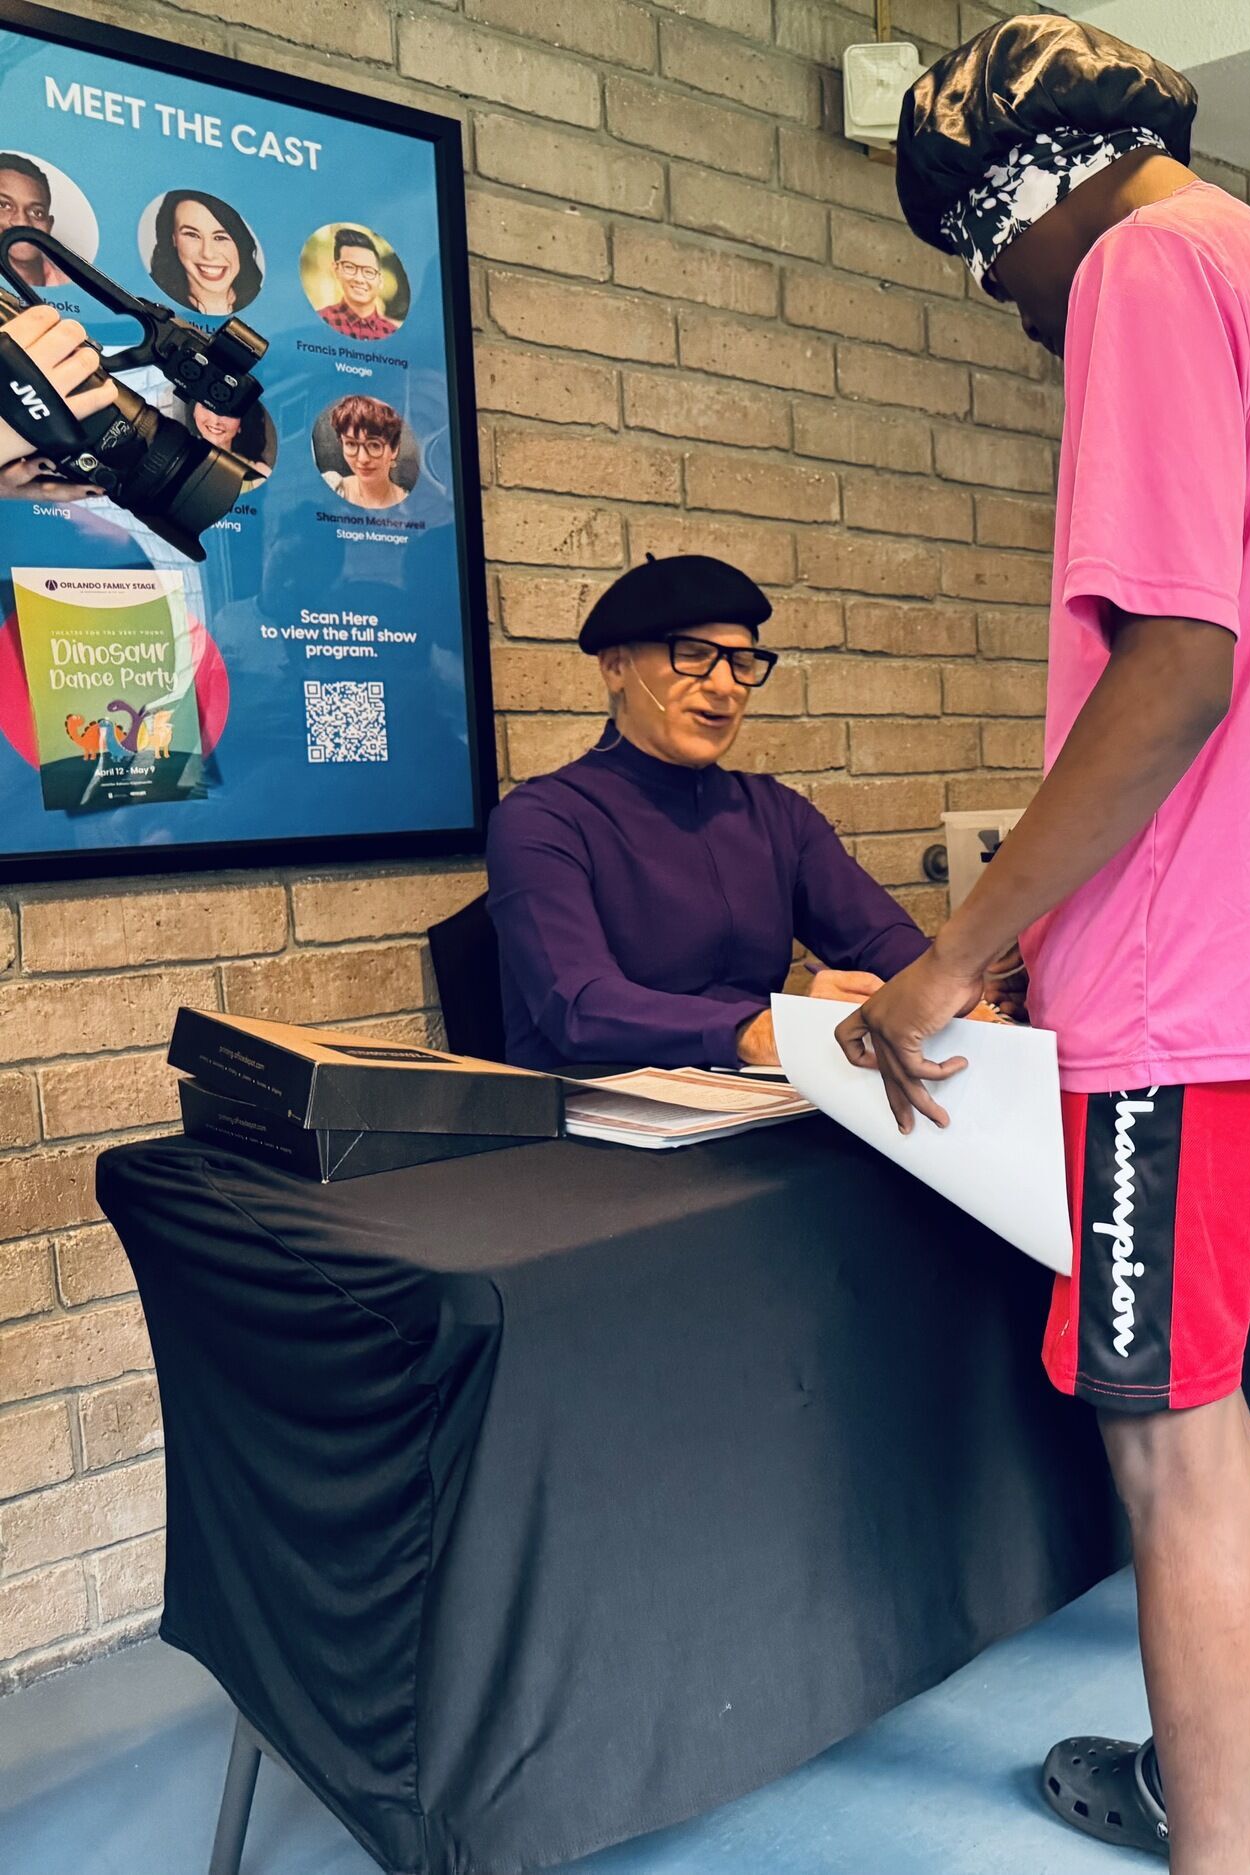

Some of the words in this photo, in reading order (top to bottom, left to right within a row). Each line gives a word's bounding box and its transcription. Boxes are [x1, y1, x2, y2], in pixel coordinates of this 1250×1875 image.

[45, 76, 146, 128] MEET
[154, 103, 223, 148] THE
[231, 124, 322, 170] CAST
[297, 341, 337, 356] Francis
[10, 380, 50, 421] JVC
[33, 504, 71, 520] Swing
[316, 512, 364, 525] Shannon
[336, 528, 365, 542] Stage
[366, 531, 408, 545] Manager
[60, 581, 101, 590] ORLANDO
[103, 582, 131, 590] FAMILY
[132, 583, 156, 591] STAGE
[300, 609, 339, 624] Scan
[342, 612, 378, 627] Here
[260, 625, 278, 639] to
[280, 626, 319, 640] view
[323, 627, 349, 641] the
[351, 627, 375, 642] full
[377, 629, 417, 643] show
[50, 638, 169, 666] Dinosaur
[305, 645, 378, 660] program.
[49, 668, 114, 690] Dance
[120, 667, 178, 692] Party
[95, 768, 115, 778] April
[115, 767, 125, 776] 12
[130, 766, 149, 776] May
[149, 765, 156, 774] 9
[1092, 1085, 1160, 1358] hampion
